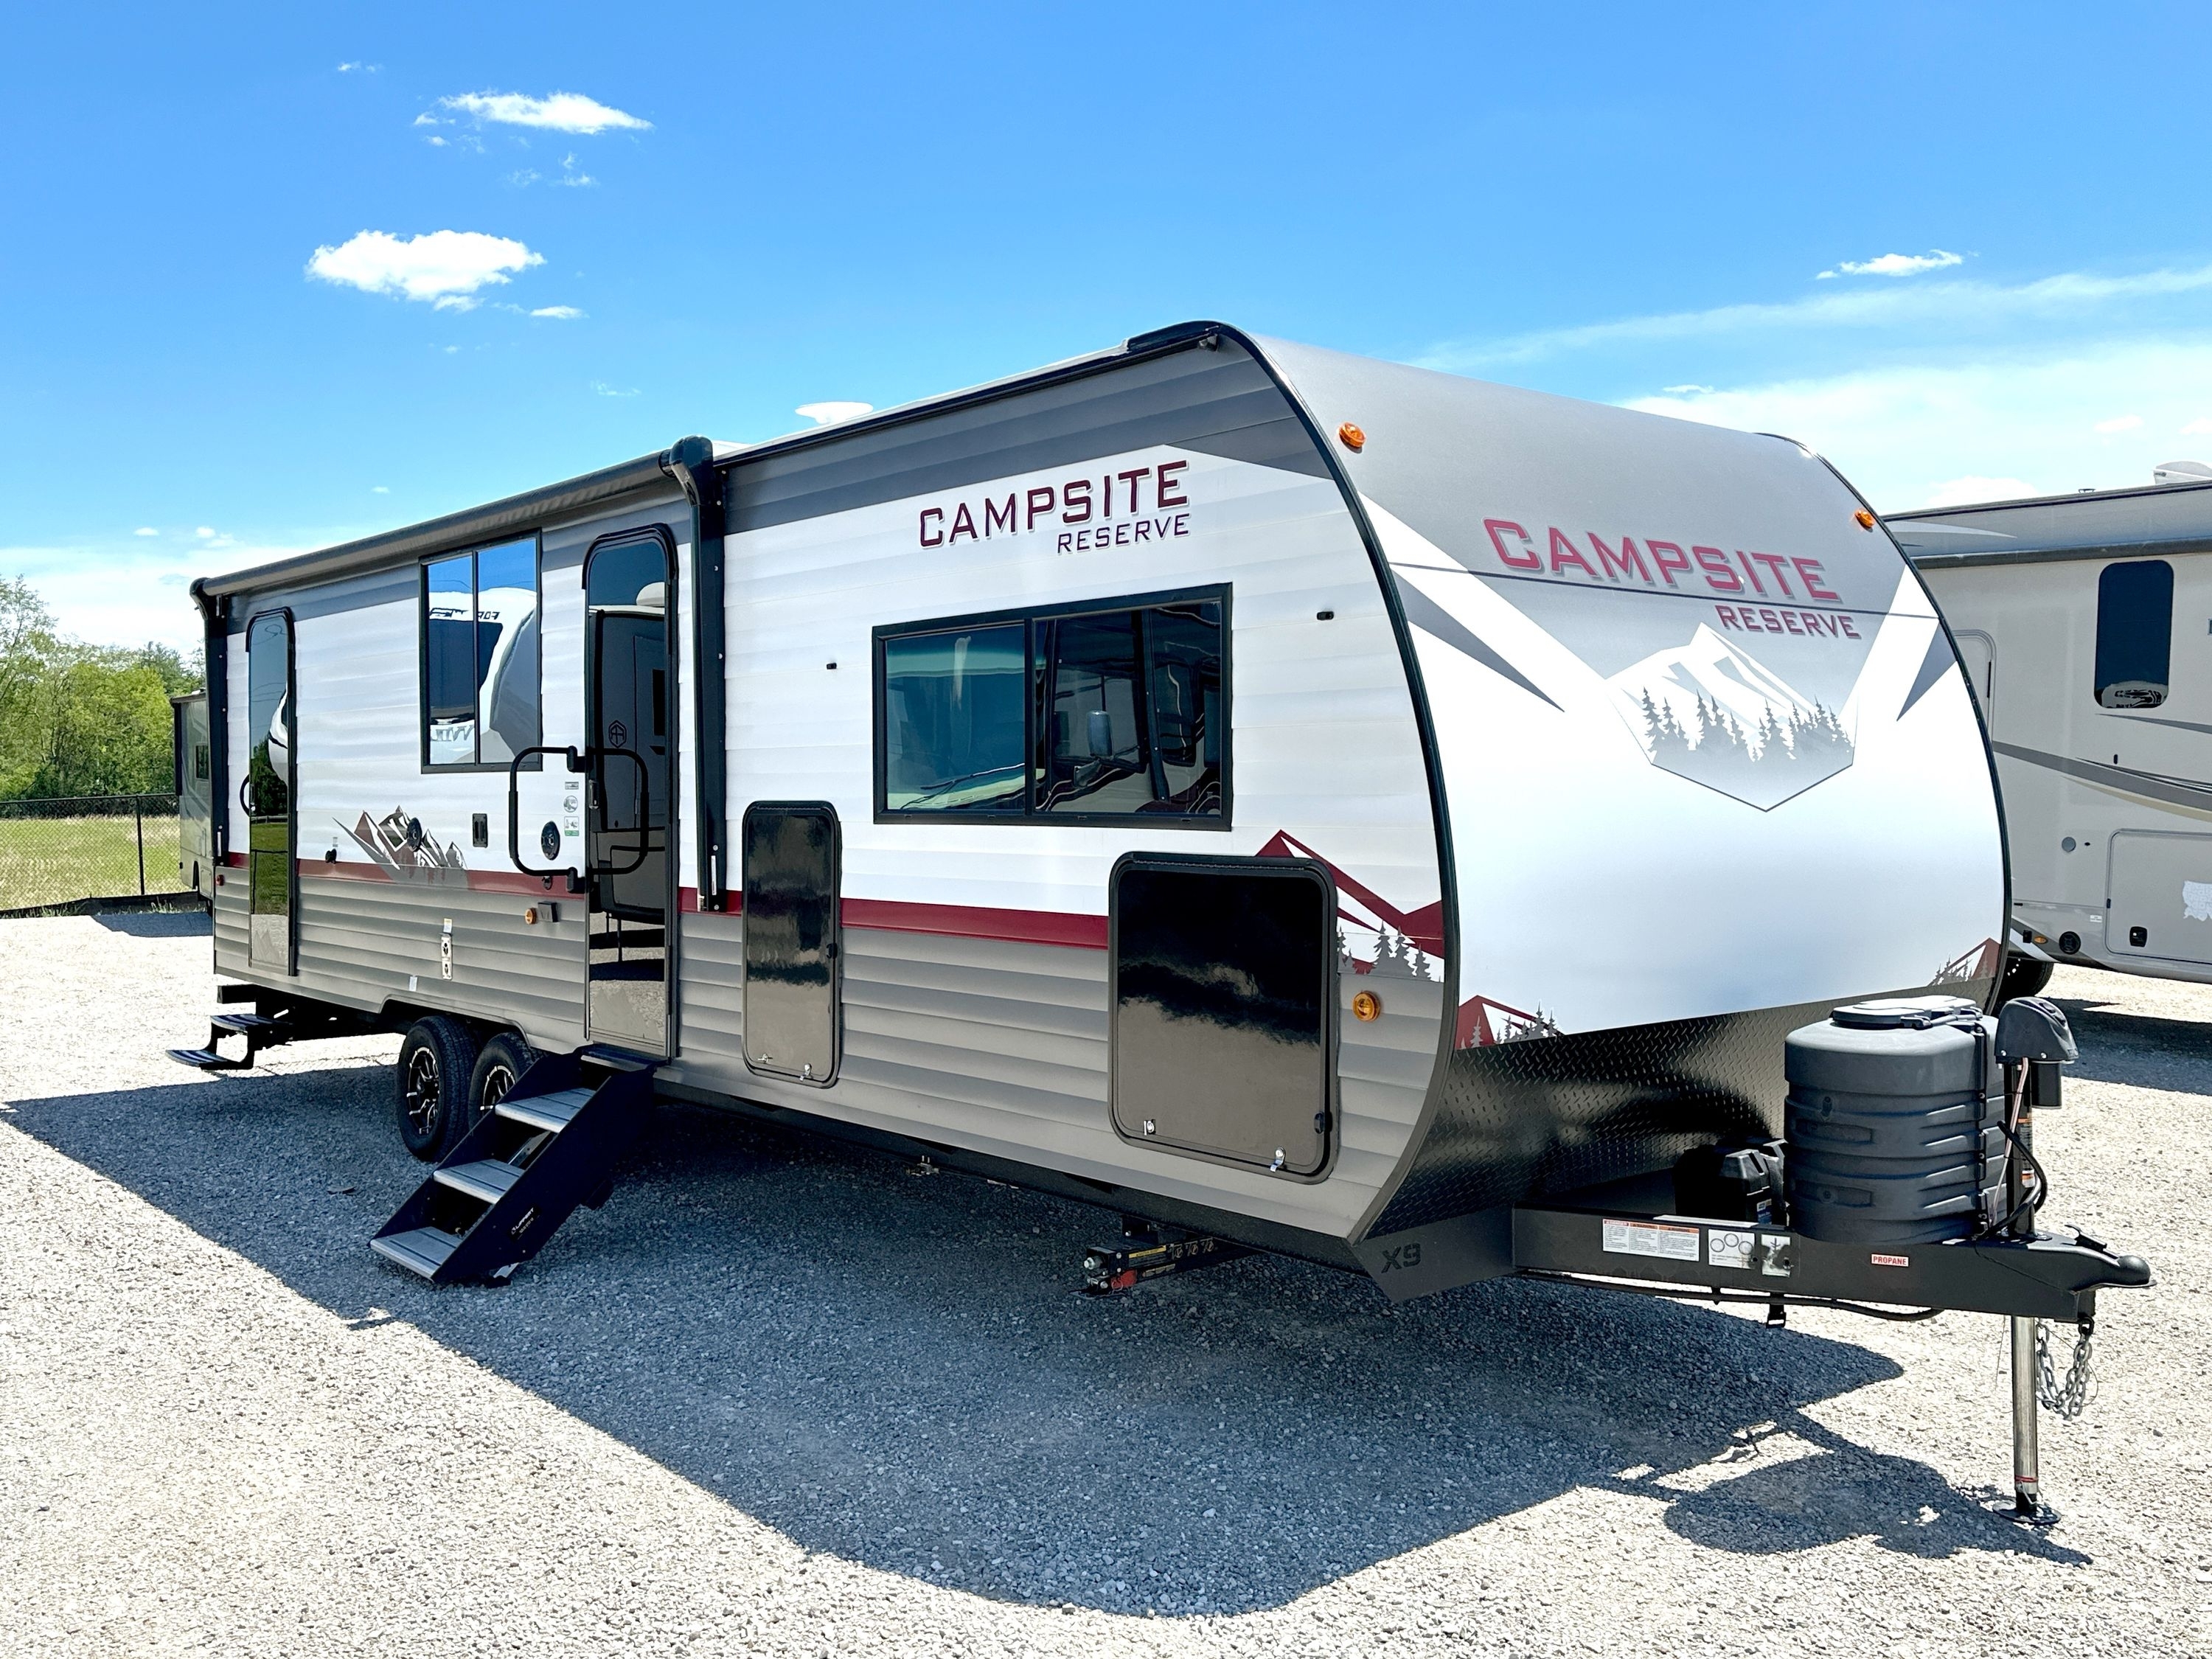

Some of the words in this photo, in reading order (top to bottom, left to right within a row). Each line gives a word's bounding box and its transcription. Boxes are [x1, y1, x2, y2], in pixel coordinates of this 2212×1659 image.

[920, 459, 1189, 548] CAMPSITE
[1057, 513, 1190, 554] RESERVE
[1482, 517, 1843, 602] CAMPSITE
[1714, 605, 1862, 639] RESERVE
[1380, 1242, 1422, 1274] X9
[1873, 1256, 1907, 1265] PROPANE
